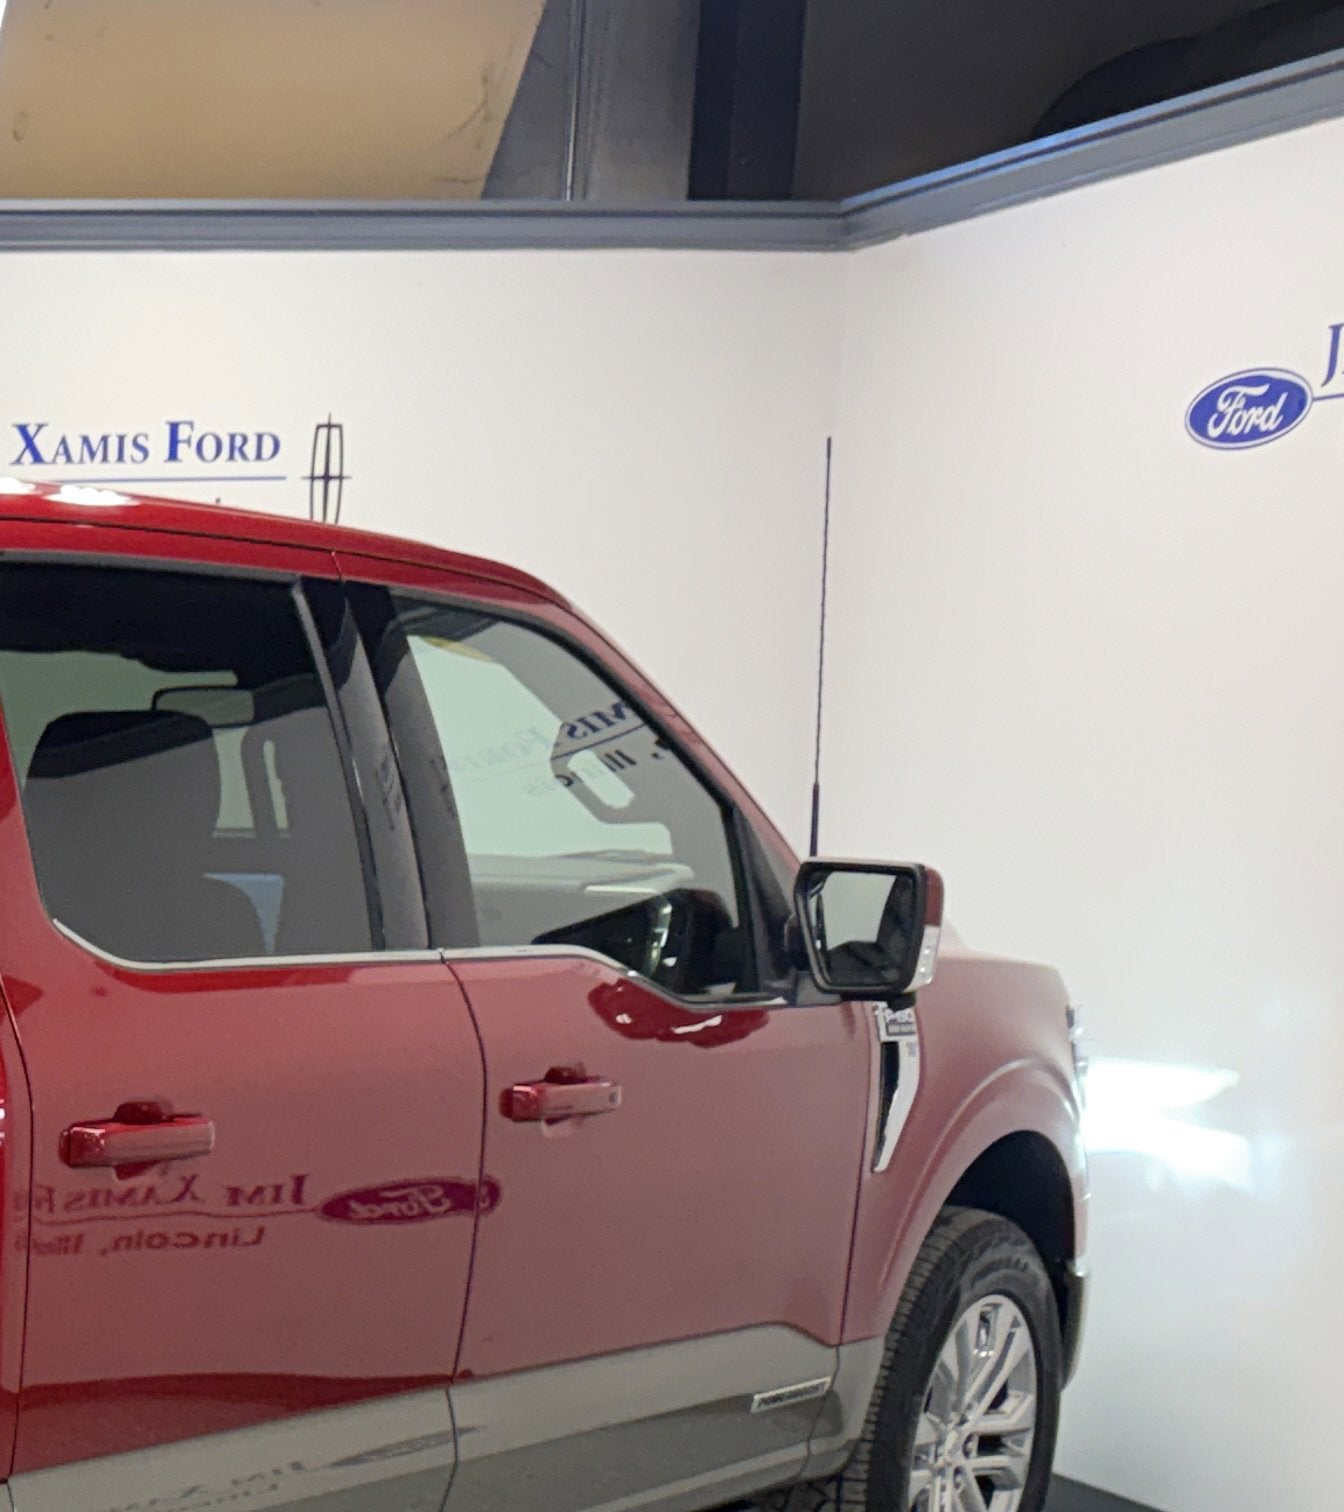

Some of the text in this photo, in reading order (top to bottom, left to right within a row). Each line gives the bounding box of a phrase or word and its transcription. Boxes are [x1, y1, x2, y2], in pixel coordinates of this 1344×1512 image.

[1207, 382, 1288, 438] Ford
[11, 422, 149, 466] XAMIS
[165, 420, 282, 464] FORD
